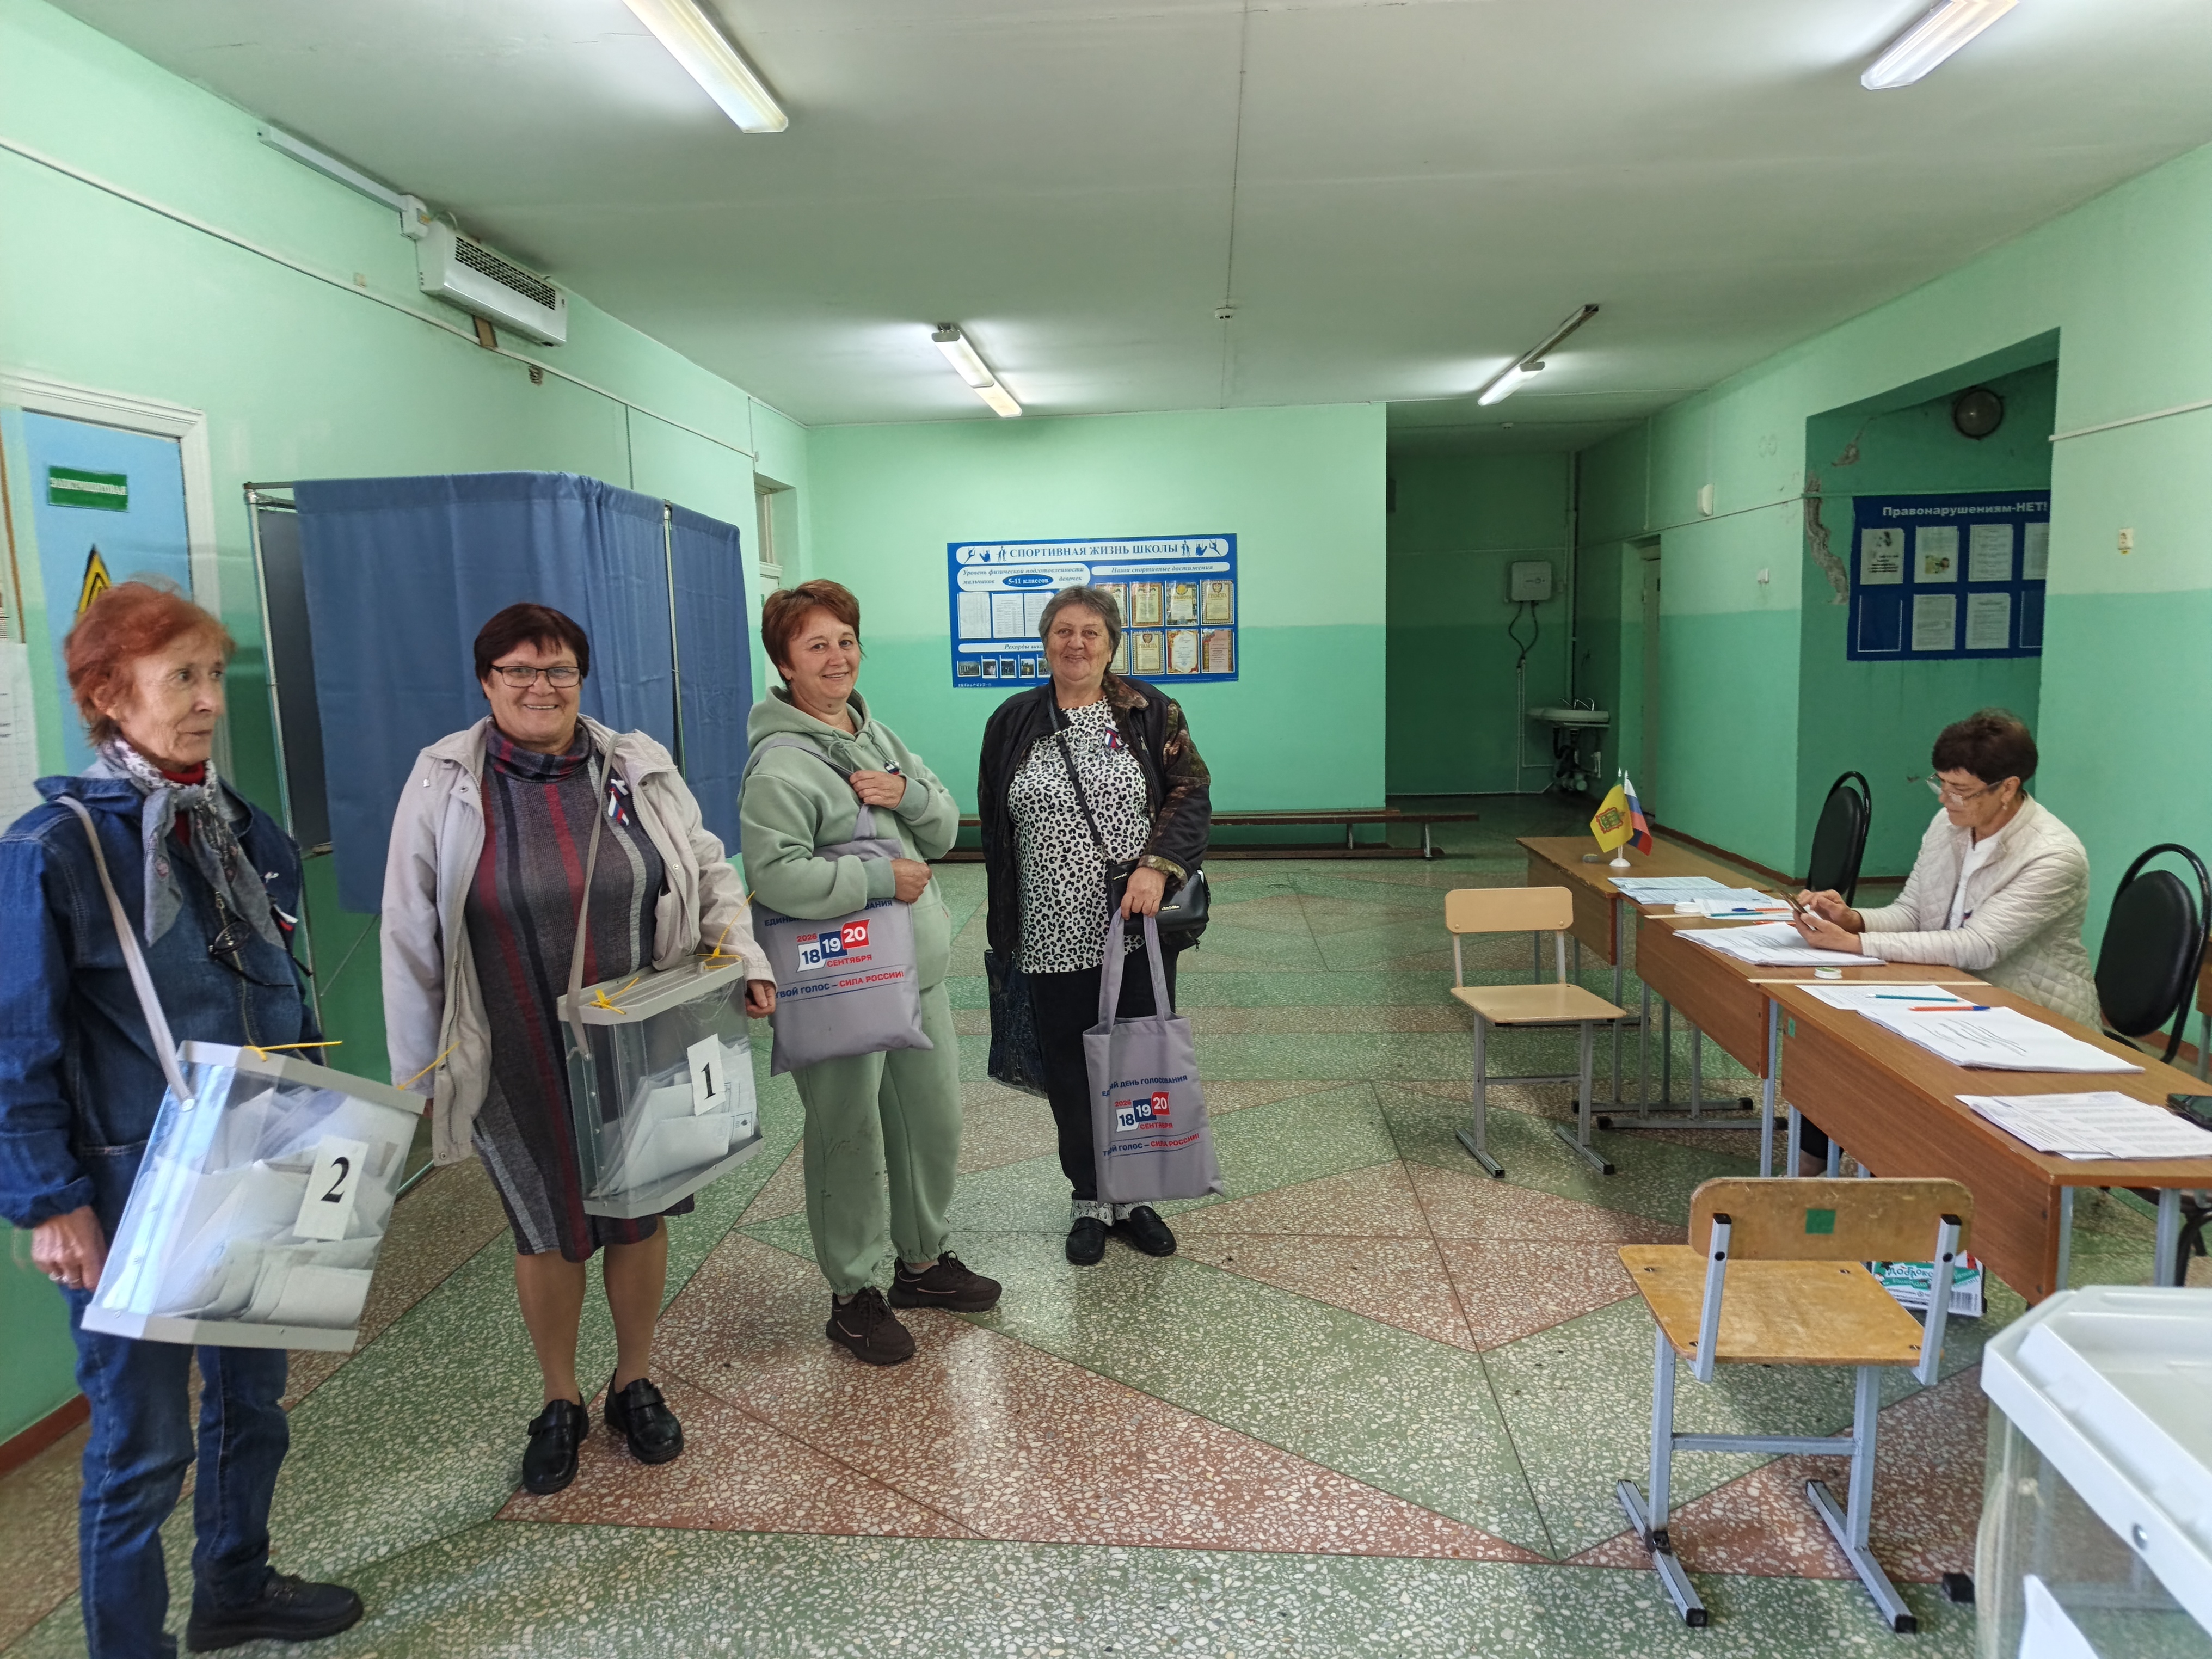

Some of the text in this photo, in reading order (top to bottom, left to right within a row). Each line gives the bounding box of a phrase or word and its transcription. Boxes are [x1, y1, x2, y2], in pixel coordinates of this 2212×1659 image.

[1882, 502, 2048, 518] Правонарушениям-НЕТ!
[1010, 543, 1178, 557] СПОРТИВНАЯ ЖИЗНЬ ШКОЛЫ
[988, 568, 1024, 576] физической
[1025, 566, 1084, 574] подготовленности
[1132, 565, 1171, 573] спортивные
[796, 933, 818, 942] 2026
[801, 926, 867, 964] 18 19 20
[826, 954, 872, 967] СЕНТЯБРЯ
[801, 982, 831, 995] ГОЛОС
[839, 976, 864, 988] СИЛА
[865, 970, 904, 982] РОССИИ!
[701, 1062, 716, 1101] 1
[1120, 1079, 1140, 1088] ДЕНЬ
[1141, 1074, 1188, 1085] ГОЛОСОВАНИЯ
[1119, 1096, 1168, 1127] 18 19 20
[1119, 1142, 1143, 1152] ГОЛОС
[1169, 1133, 1200, 1147] РОССИИ!
[320, 1156, 351, 1203] 2
